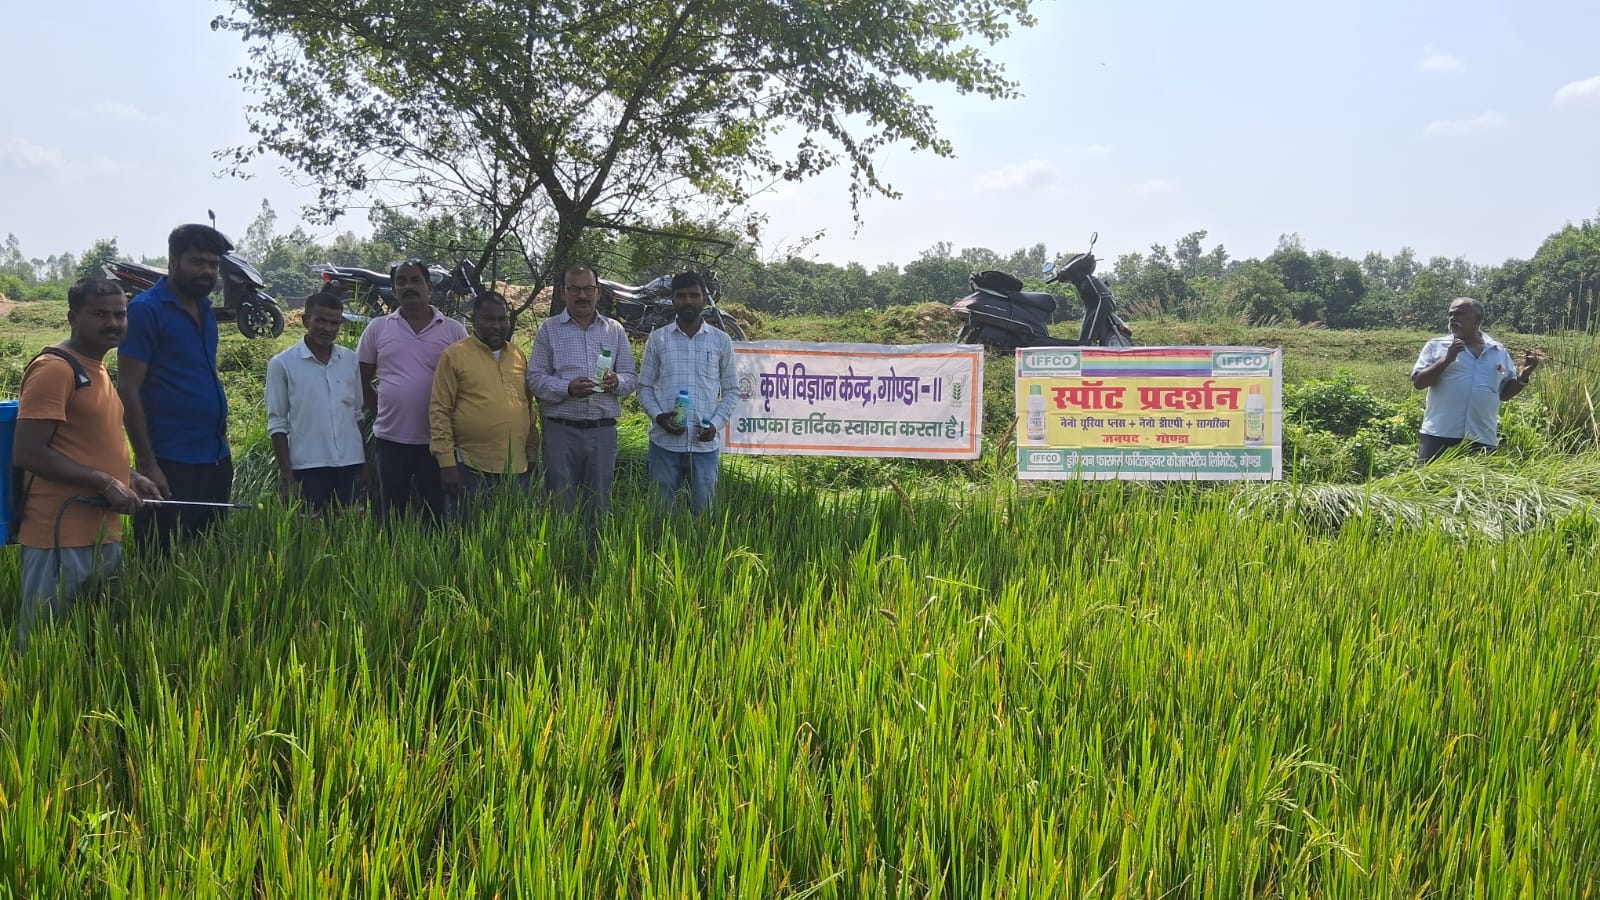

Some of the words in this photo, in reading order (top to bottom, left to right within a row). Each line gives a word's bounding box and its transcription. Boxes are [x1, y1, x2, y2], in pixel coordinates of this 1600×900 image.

[1031, 356, 1072, 366] IFFCO
[1222, 356, 1262, 366] IFFCO
[760, 361, 790, 412] कृषि
[792, 362, 837, 405] विज्ञान
[1051, 380, 1127, 410] स्पॉट
[1137, 380, 1242, 411] प्रदर्शन
[736, 417, 790, 433] आपका
[791, 412, 842, 435] हार्दिक
[844, 420, 898, 436] स्वागत
[900, 420, 943, 437] करता
[1107, 418, 1126, 428] प्लस
[1129, 420, 1136, 428] +
[1158, 416, 1183, 428] डीएपी
[1186, 420, 1193, 428] +
[1196, 417, 1231, 428] सागरिका
[1101, 434, 1140, 443] जनपद
[1155, 432, 1190, 443] गोण्डा
[1033, 454, 1058, 462] IFFCO
[1239, 452, 1262, 467] गोण्डा
